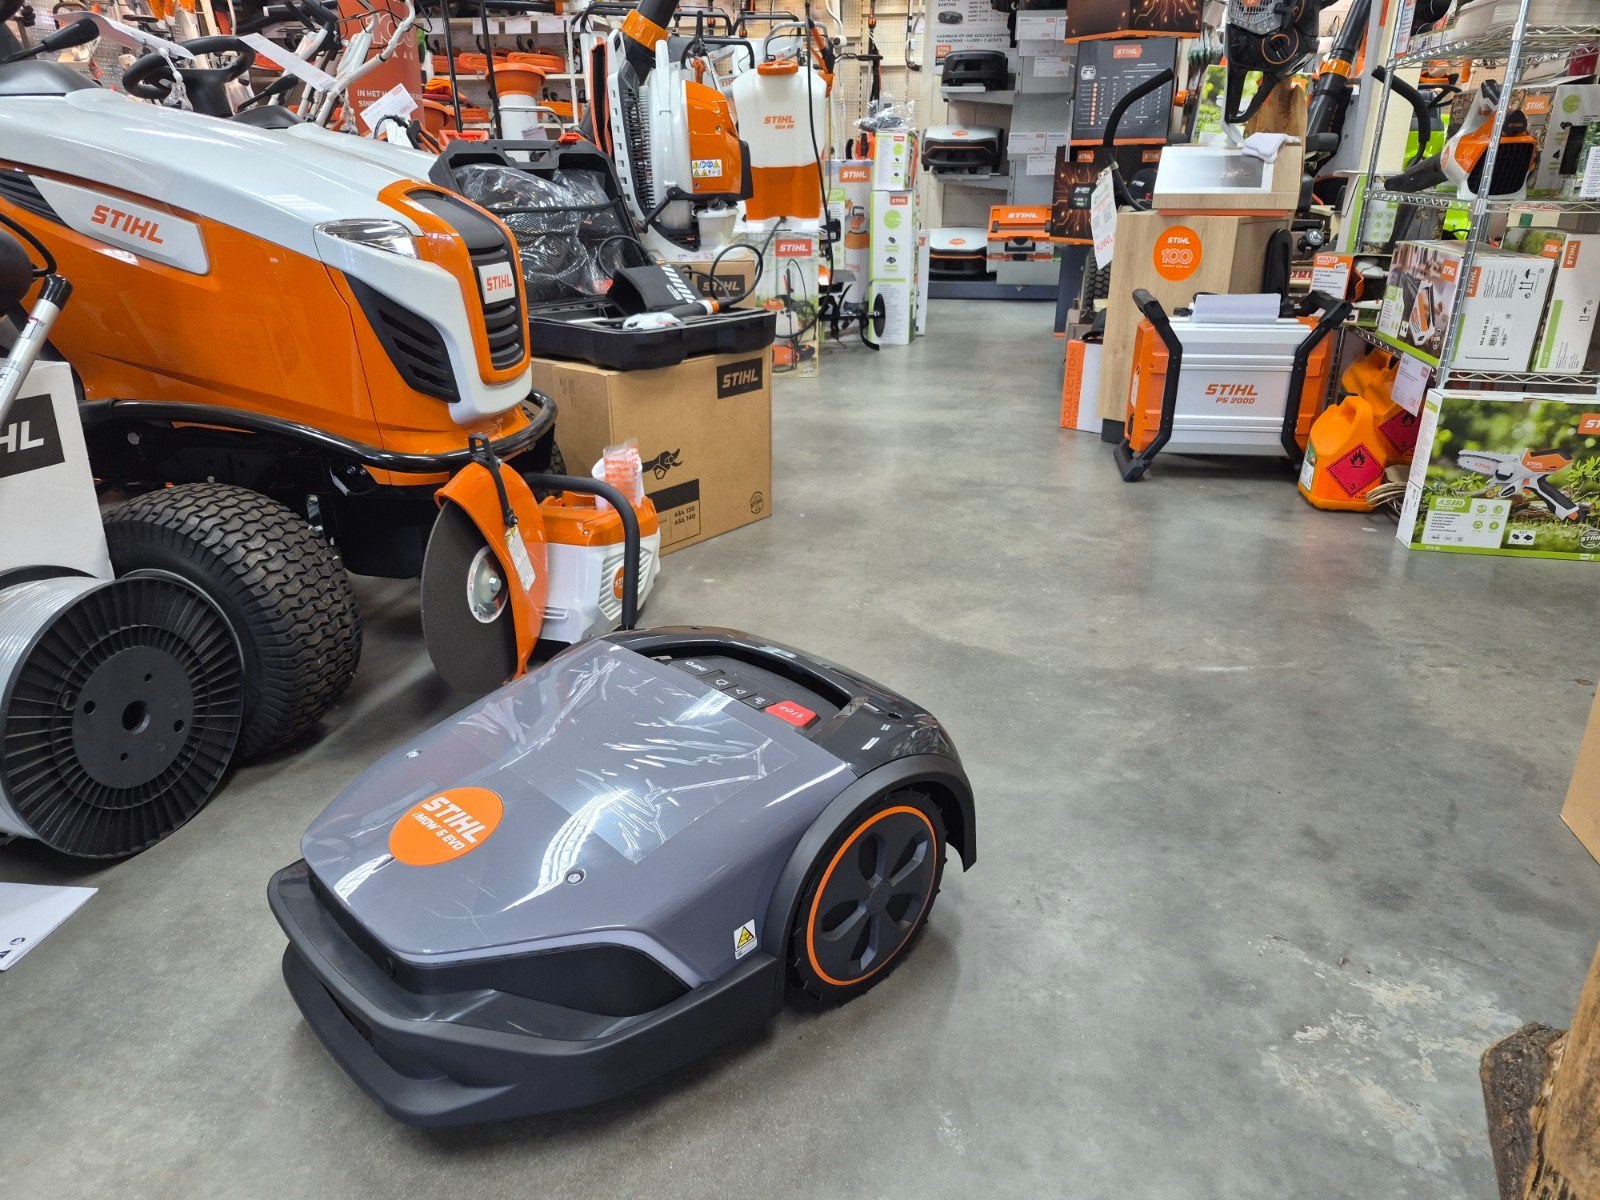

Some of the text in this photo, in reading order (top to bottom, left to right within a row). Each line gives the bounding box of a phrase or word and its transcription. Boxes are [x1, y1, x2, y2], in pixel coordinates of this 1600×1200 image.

[763, 115, 795, 125] STIHL
[842, 171, 867, 179] STIHL
[90, 205, 164, 245] STIHL
[779, 244, 809, 253] STIHL
[1166, 236, 1191, 245] STIHL
[1544, 243, 1559, 253] STIHL
[1161, 247, 1194, 265] 100
[1566, 243, 1578, 265] STIHL
[486, 273, 513, 292] STIHL
[1466, 269, 1478, 294] STIHL
[722, 368, 760, 390] STIHL
[1204, 383, 1259, 396] STIHL
[1230, 397, 1256, 405] 2000
[779, 703, 806, 720] STOP
[421, 796, 488, 844] STIHL
